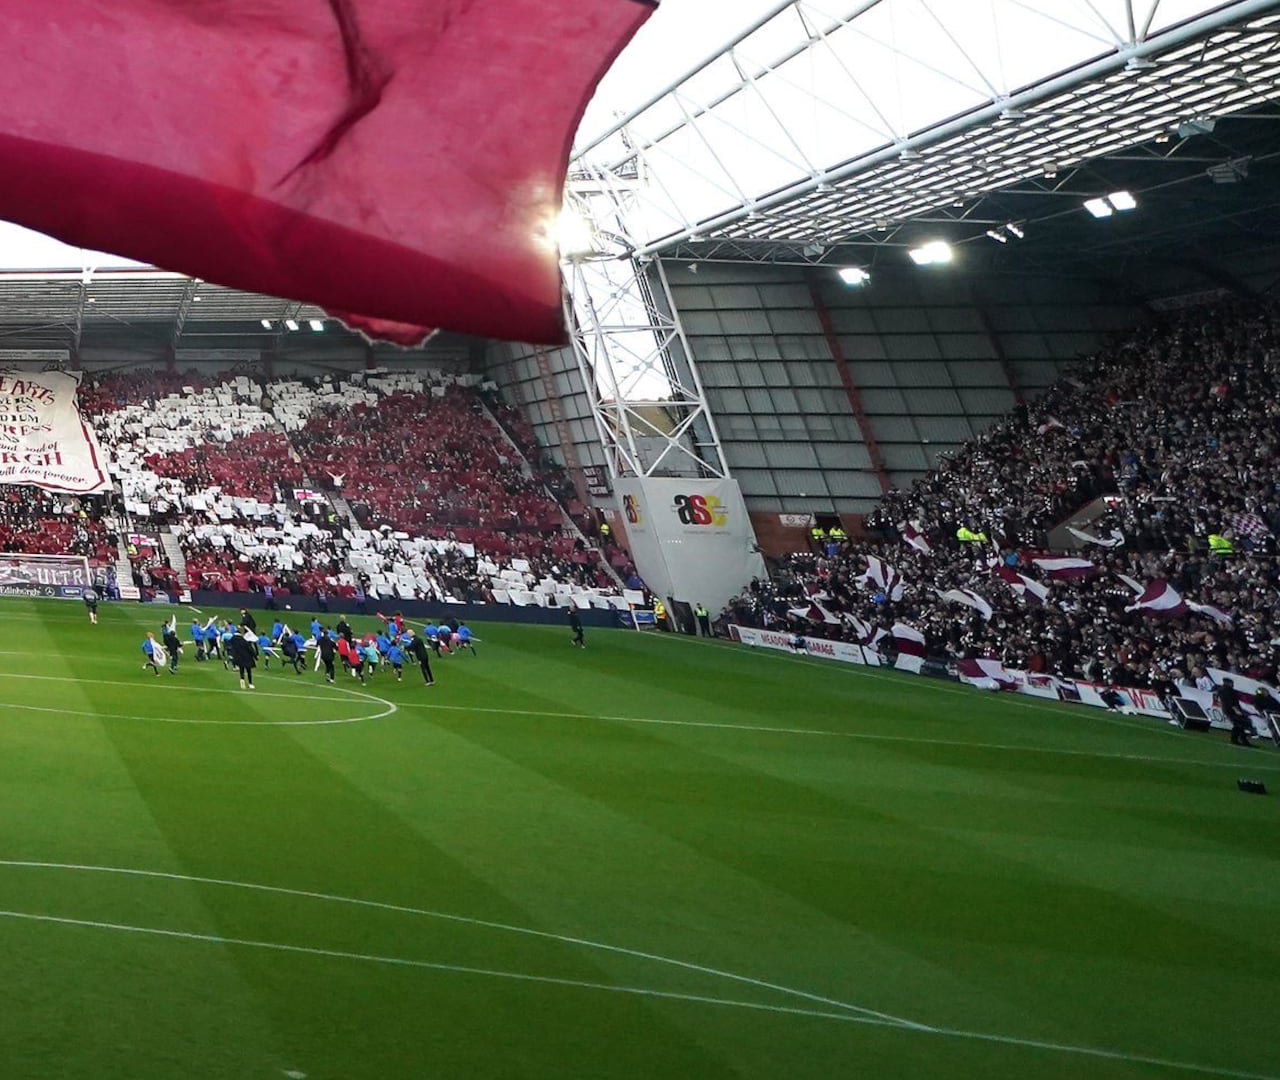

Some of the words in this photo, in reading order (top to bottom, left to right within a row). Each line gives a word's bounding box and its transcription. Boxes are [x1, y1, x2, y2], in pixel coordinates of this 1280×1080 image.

[47, 441, 59, 452] of
[673, 494, 727, 527] asc
[0, 584, 41, 597] Edinburgh
[807, 639, 836, 656] GARAGE
